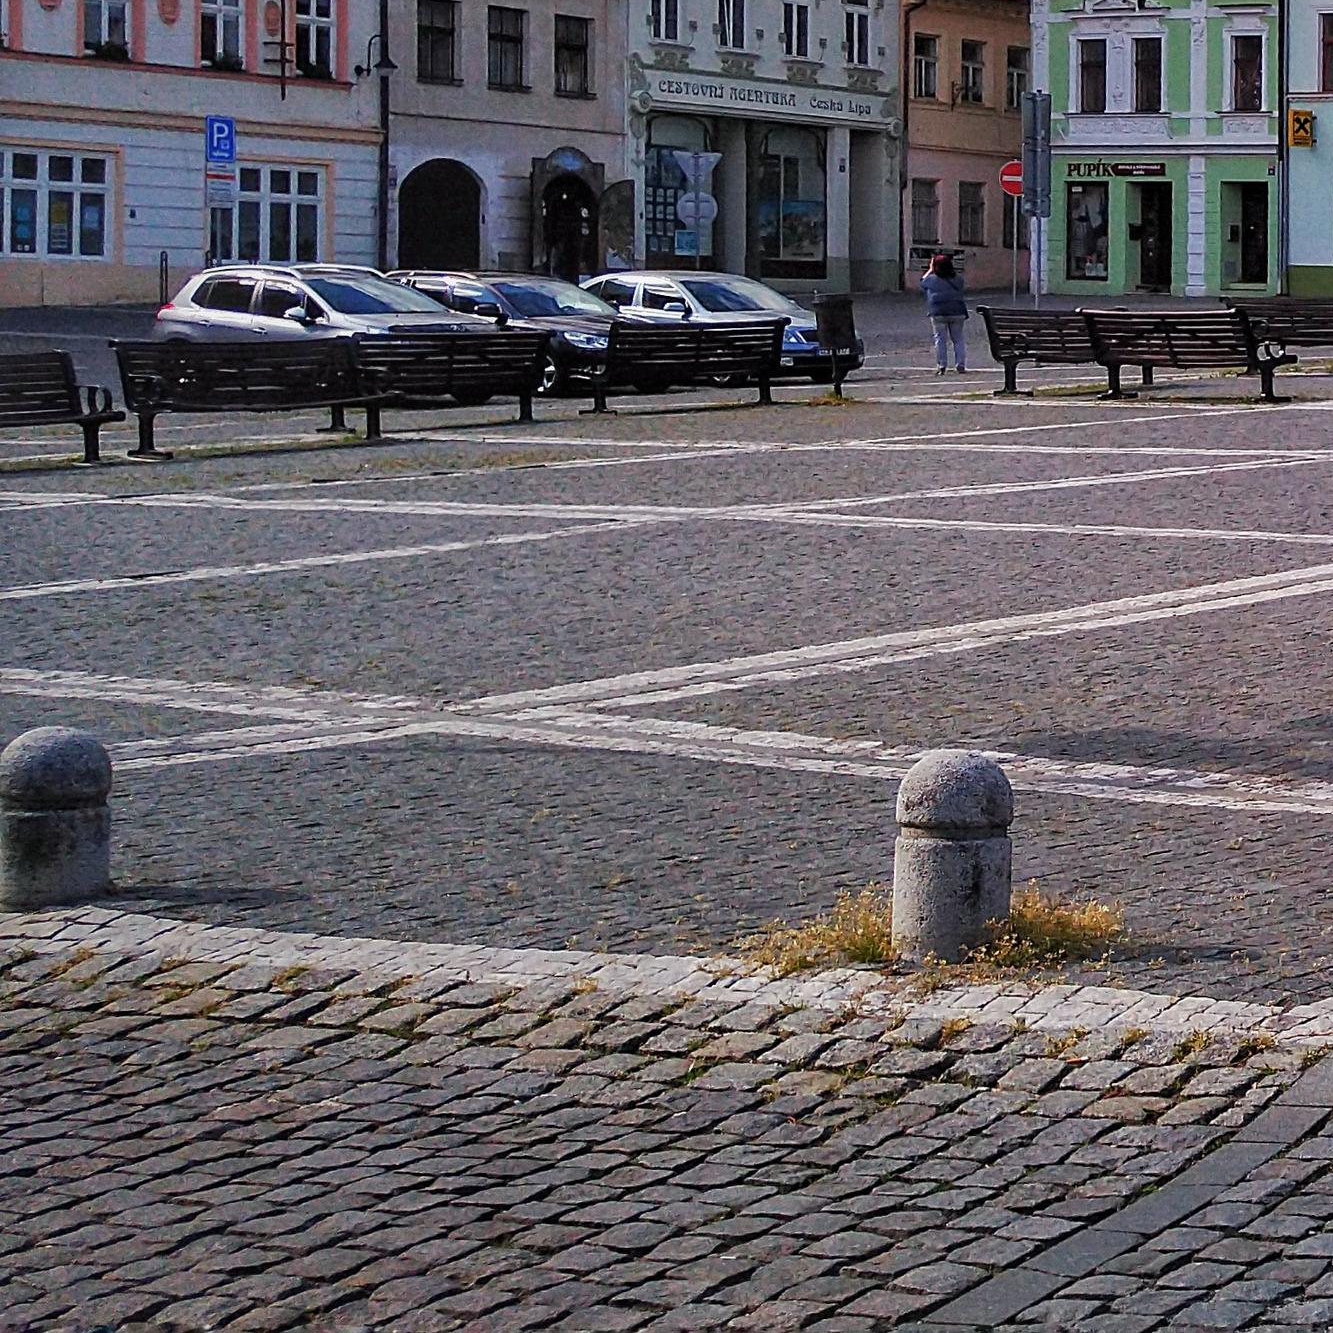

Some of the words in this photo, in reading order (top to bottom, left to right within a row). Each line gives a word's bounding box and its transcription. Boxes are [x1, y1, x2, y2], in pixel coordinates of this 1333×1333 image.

[658, 79, 724, 99] CESTOVNÍ
[729, 86, 797, 107] AGENTURA
[213, 122, 229, 147] P
[1067, 158, 1114, 177] PUPÍK
